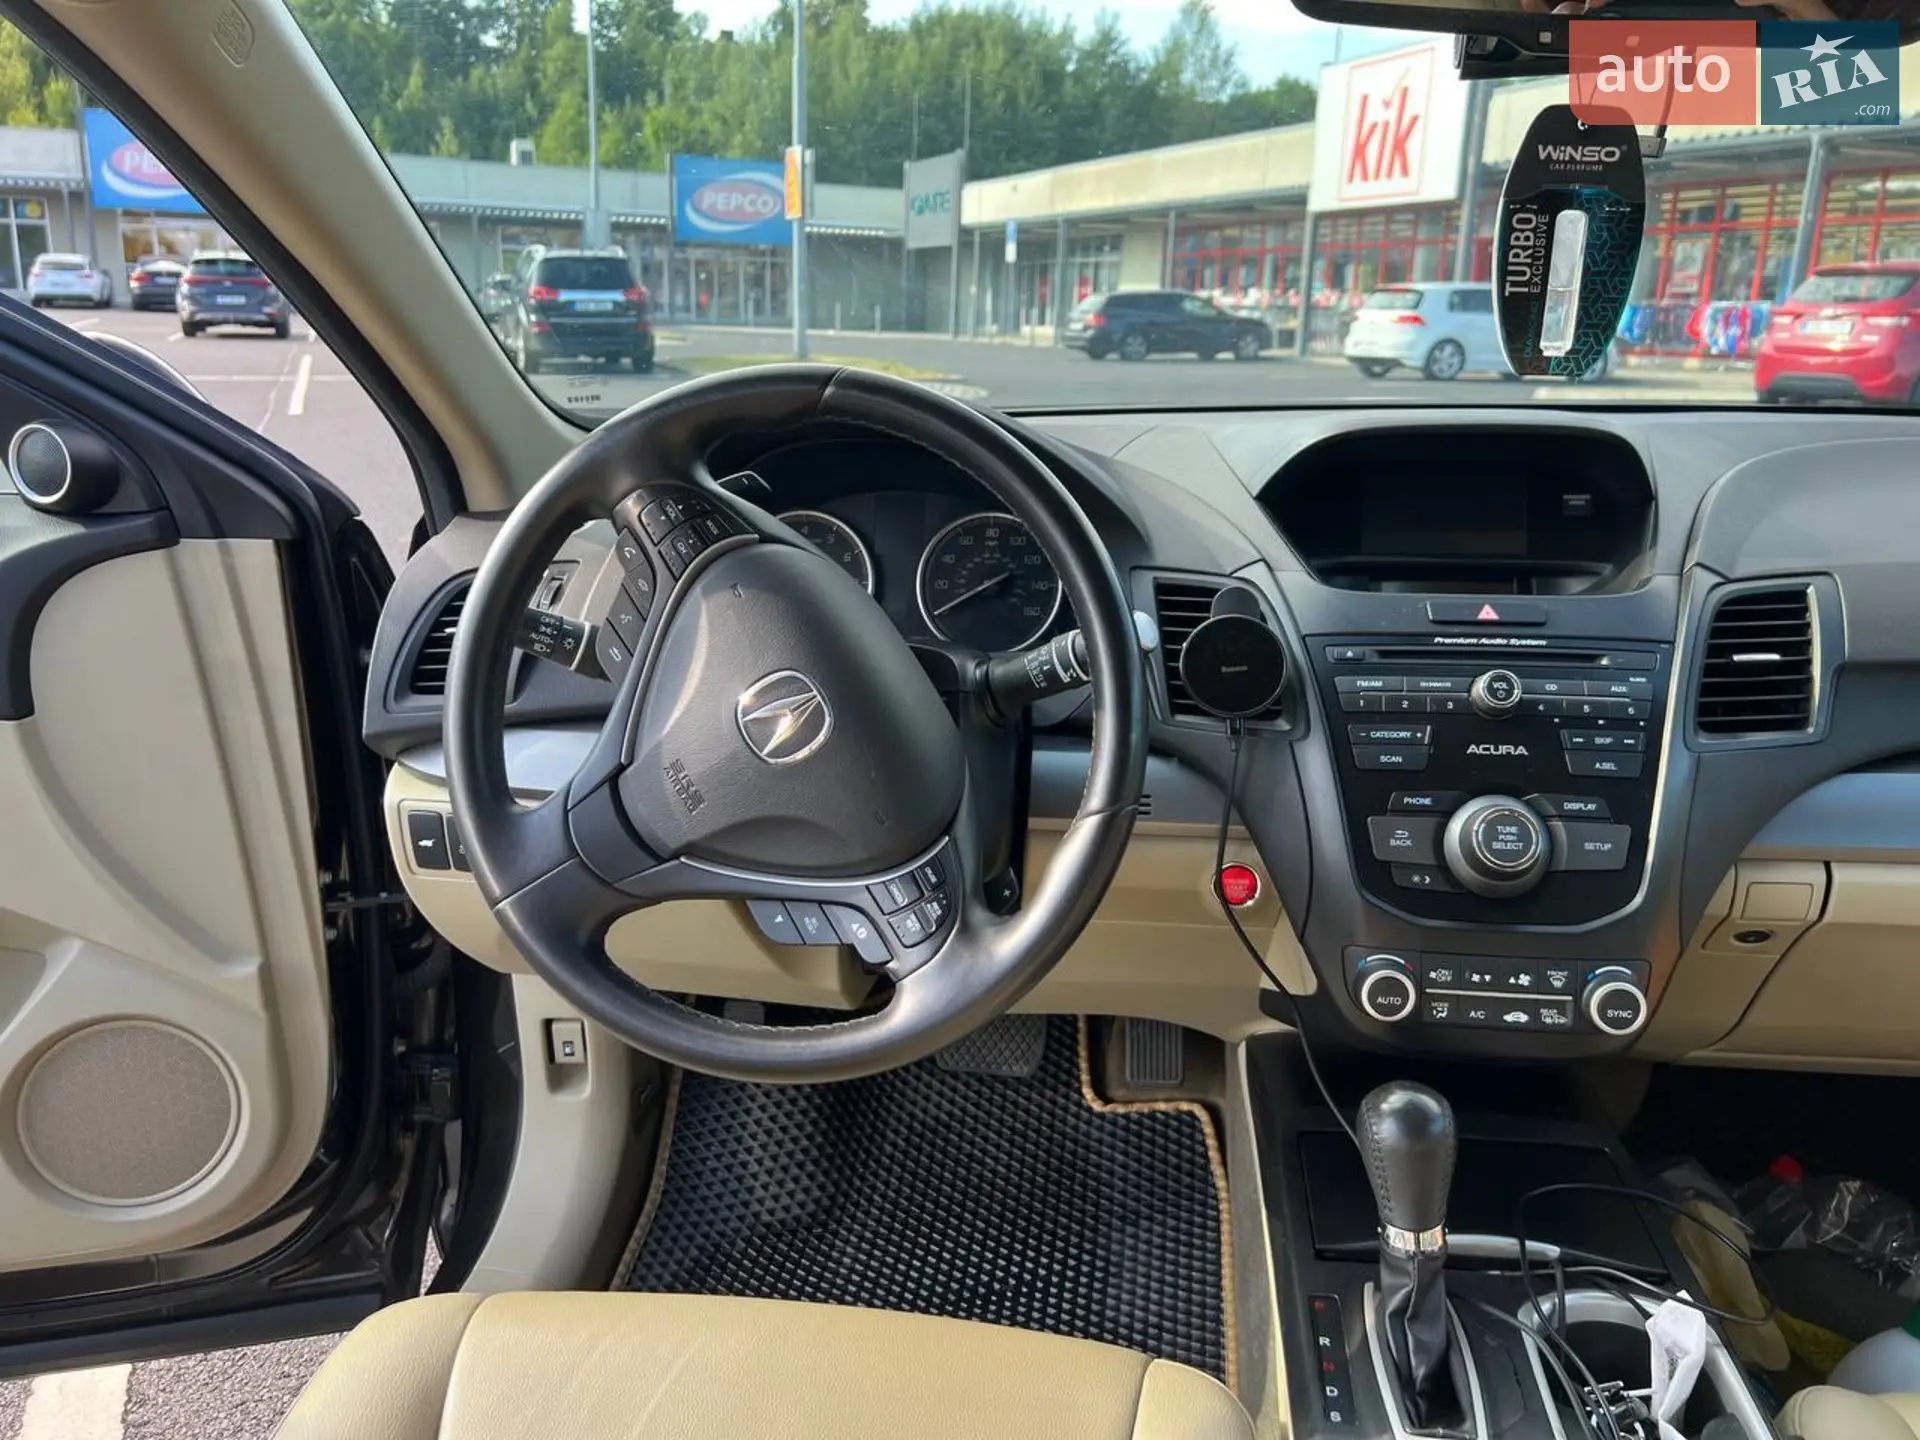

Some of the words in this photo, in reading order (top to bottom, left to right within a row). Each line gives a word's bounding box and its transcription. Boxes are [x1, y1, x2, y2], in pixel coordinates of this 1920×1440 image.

[1346, 85, 1420, 185] kik
[702, 190, 774, 213] PEPCO
[1504, 212, 1537, 296] TURBO
[1529, 213, 1549, 293] EXCLUSIVE
[1479, 637, 1507, 645] Audio
[1492, 681, 1509, 690] VOL
[1544, 683, 1558, 691] CD
[1370, 731, 1412, 739] CATEGORY
[1594, 736, 1613, 744] SKIP
[1466, 744, 1529, 756] ACURA
[1380, 755, 1402, 763] SCAN
[1403, 797, 1432, 805] PHONE
[1563, 802, 1597, 811] DISPLAY
[1496, 825, 1519, 834] TUNE
[1389, 838, 1412, 847] BACK
[1492, 841, 1524, 850] SELECT
[1584, 842, 1612, 851] SETUP
[1376, 996, 1402, 1005] AUTO
[1469, 1010, 1486, 1019] A/C
[1606, 1009, 1633, 1019] SYNC
[1319, 1335, 1331, 1346] R
[1322, 1360, 1335, 1372] N
[1325, 1385, 1339, 1396] D
